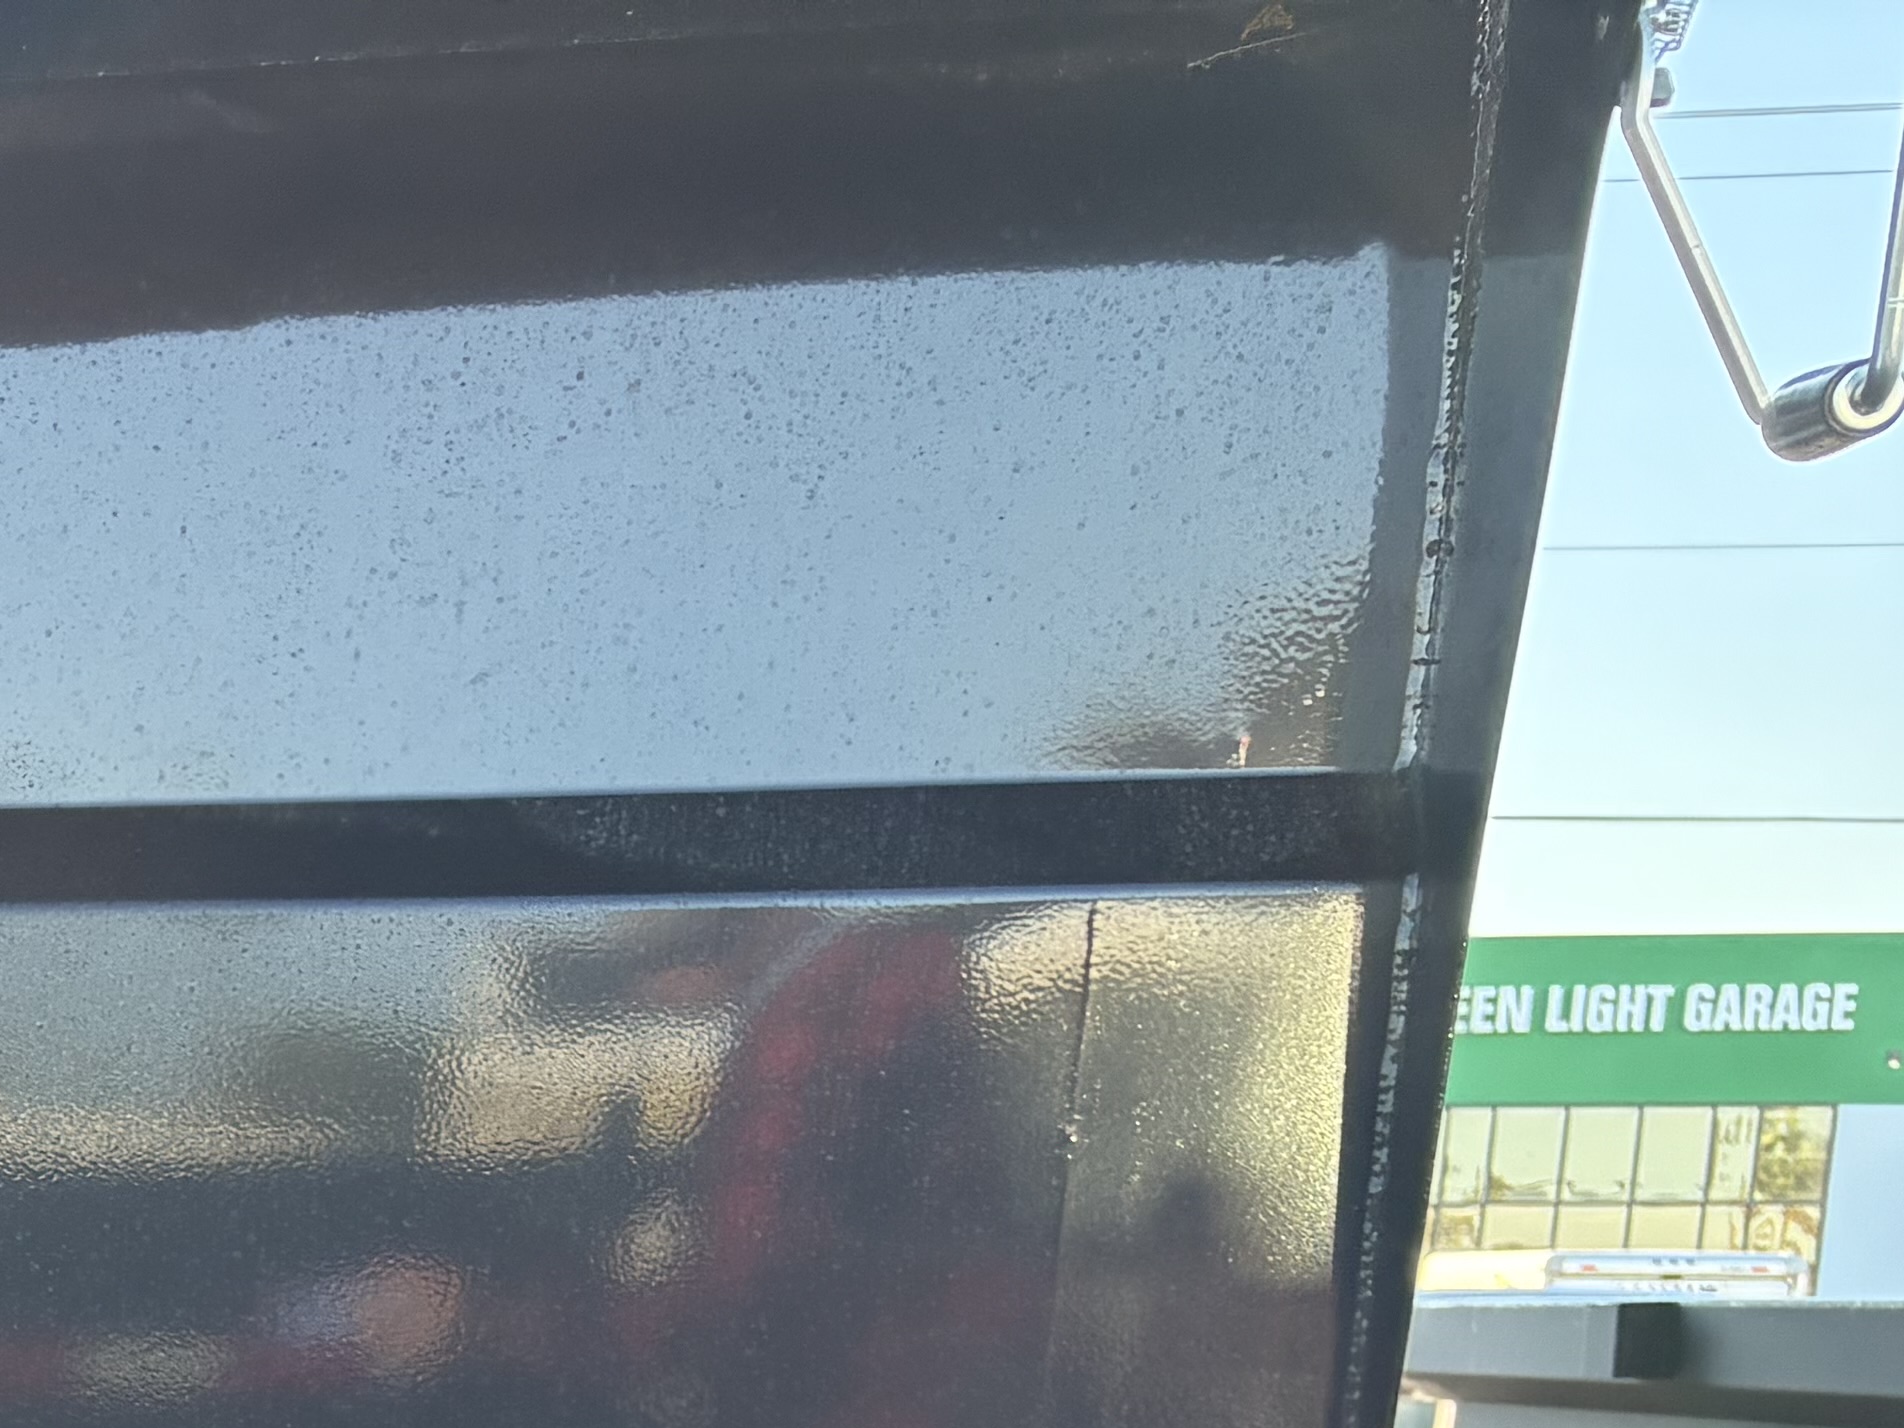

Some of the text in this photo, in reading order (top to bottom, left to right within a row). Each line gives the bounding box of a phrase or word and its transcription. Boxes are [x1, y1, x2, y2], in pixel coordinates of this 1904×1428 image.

[1455, 982, 1859, 1034] EEN LIGHT GARAGE
